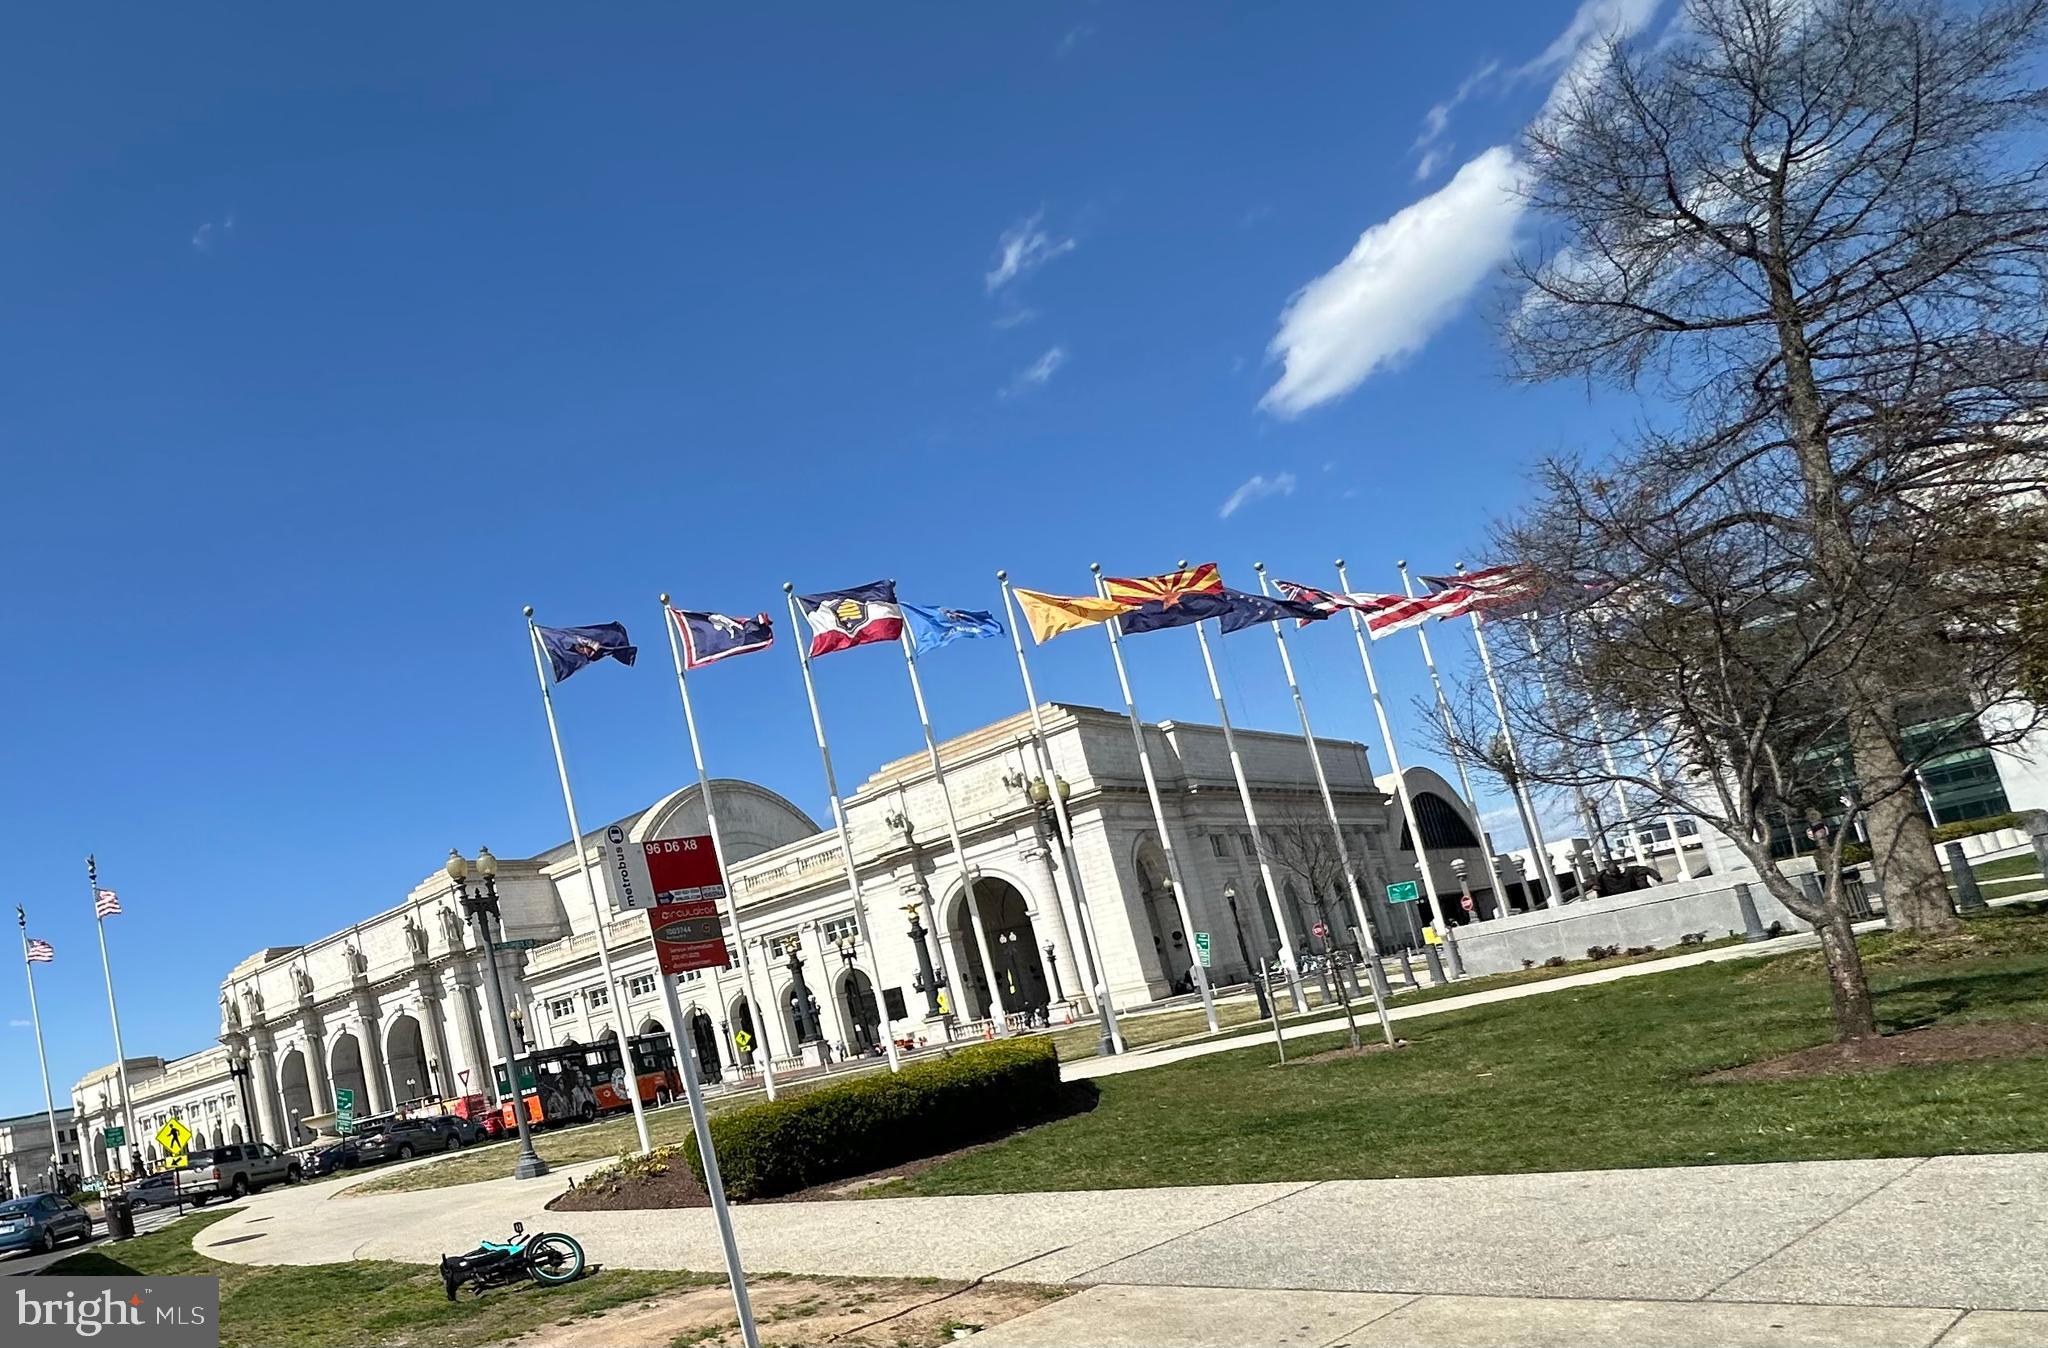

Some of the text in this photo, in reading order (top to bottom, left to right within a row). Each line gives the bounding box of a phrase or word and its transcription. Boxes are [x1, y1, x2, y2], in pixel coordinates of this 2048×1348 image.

[646, 839, 698, 855] 96 D6 X8
[615, 847, 635, 906] metrobus
